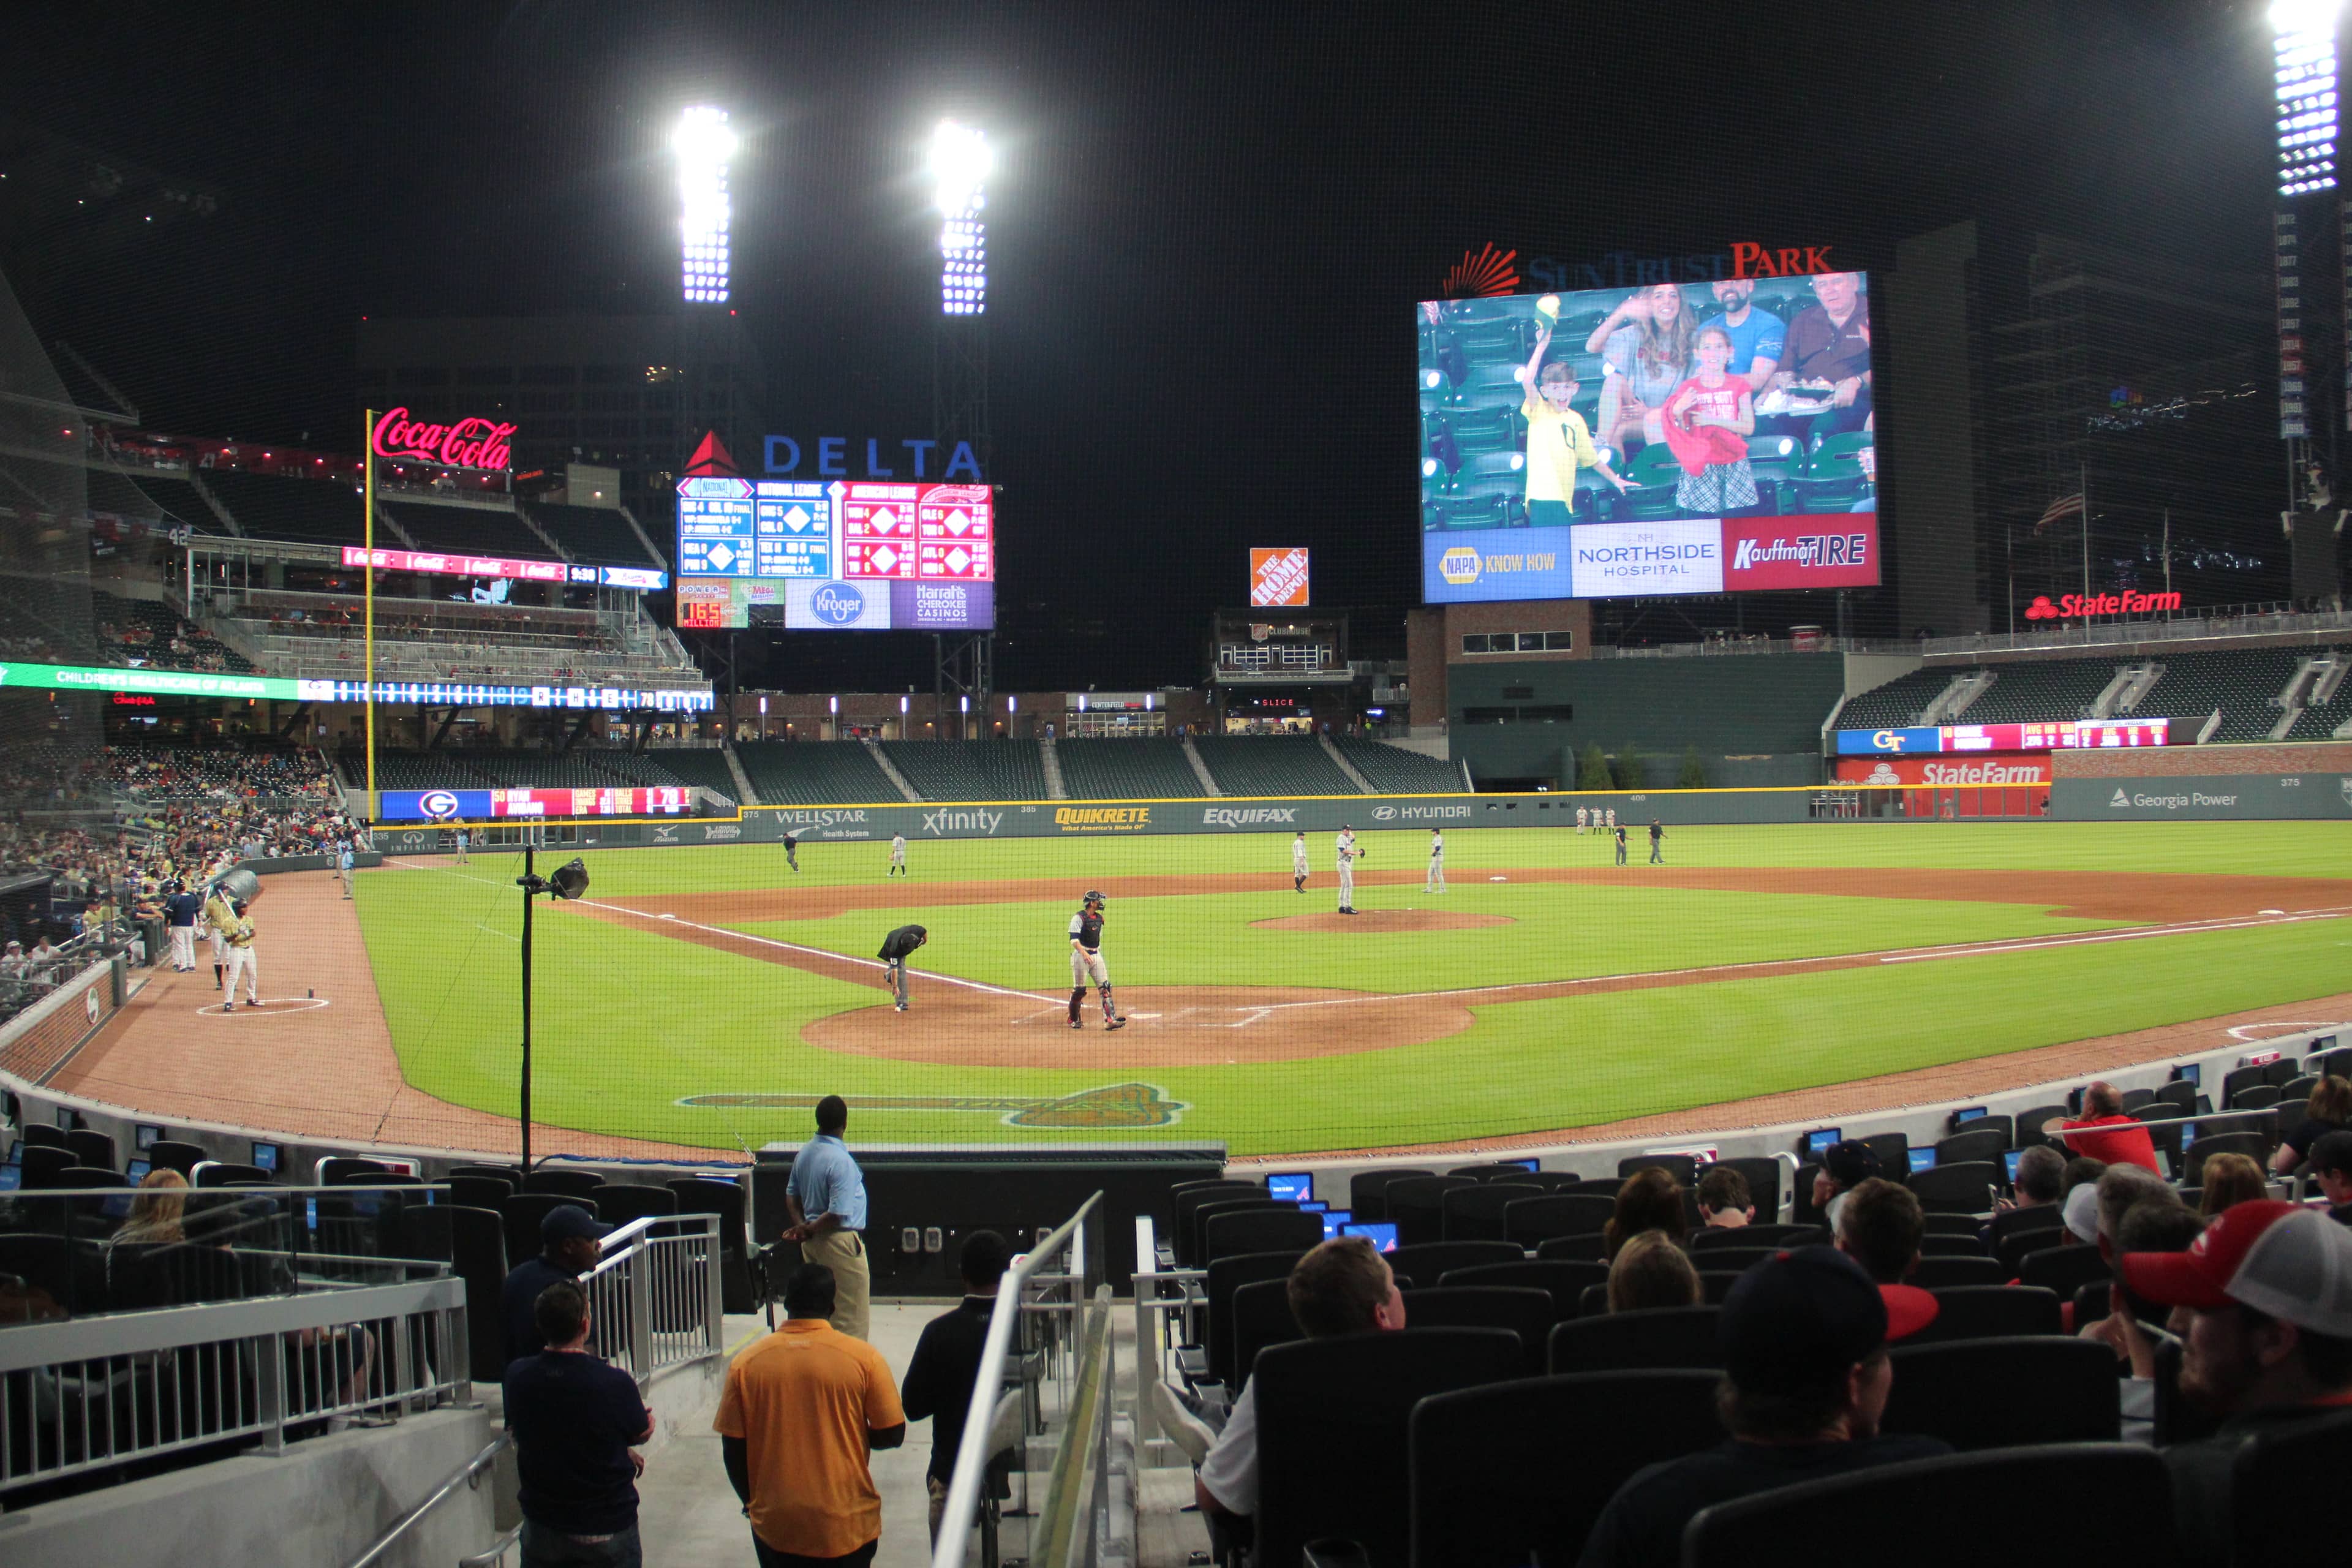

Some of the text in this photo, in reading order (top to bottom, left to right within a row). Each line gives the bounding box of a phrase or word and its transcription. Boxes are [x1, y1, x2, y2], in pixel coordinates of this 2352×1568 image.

[1730, 242, 1833, 279] PARK
[372, 407, 518, 470] Coca-Cola
[764, 434, 982, 478] DELTA
[734, 505, 751, 514] FINAL
[777, 506, 783, 516] 5
[864, 508, 870, 518] 4
[938, 510, 944, 520] 6
[864, 524, 870, 534] 2
[938, 524, 944, 535] 0
[169, 529, 187, 545] 42
[810, 545, 827, 554] FINAL
[864, 546, 870, 557] 4
[922, 547, 937, 558] ATL
[1579, 544, 1714, 563] NORTHSIDE
[1733, 534, 1866, 569] Kauffman TIRE
[701, 559, 707, 570] 9
[864, 562, 870, 573] 6
[938, 563, 944, 573] 6
[1257, 554, 1280, 577] THE
[1446, 553, 1555, 575] NAPA KNOW HOW
[1604, 565, 1690, 576] HOSPITAL
[1252, 549, 1306, 605] HOME
[1274, 569, 1308, 605] DEPOT
[816, 589, 861, 620] Kroger
[690, 603, 720, 619] 165
[57, 671, 127, 686] CHILDREN'S
[203, 679, 217, 690] OF
[221, 680, 265, 692] ATLANTA
[538, 692, 543, 701] R
[573, 693, 578, 702] H
[608, 693, 612, 703] E
[641, 693, 654, 706] 78
[2026, 723, 2075, 735] AVG HR RBI
[2103, 727, 2116, 736] AVG
[2048, 736, 2055, 745] 2
[495, 791, 505, 802] 50
[2134, 793, 2237, 809] Georgia Power
[615, 805, 633, 813] TOTAL
[1402, 806, 1471, 818] HYUNDAI
[775, 810, 865, 826] WELLSTAR
[1055, 807, 1148, 824] QUIKRETE
[1202, 808, 1295, 827] EQUIFAX
[922, 808, 1003, 835] xfinity
[715, 826, 736, 834] ARROW
[391, 843, 436, 852] INFINITI
[890, 957, 898, 966] 15
